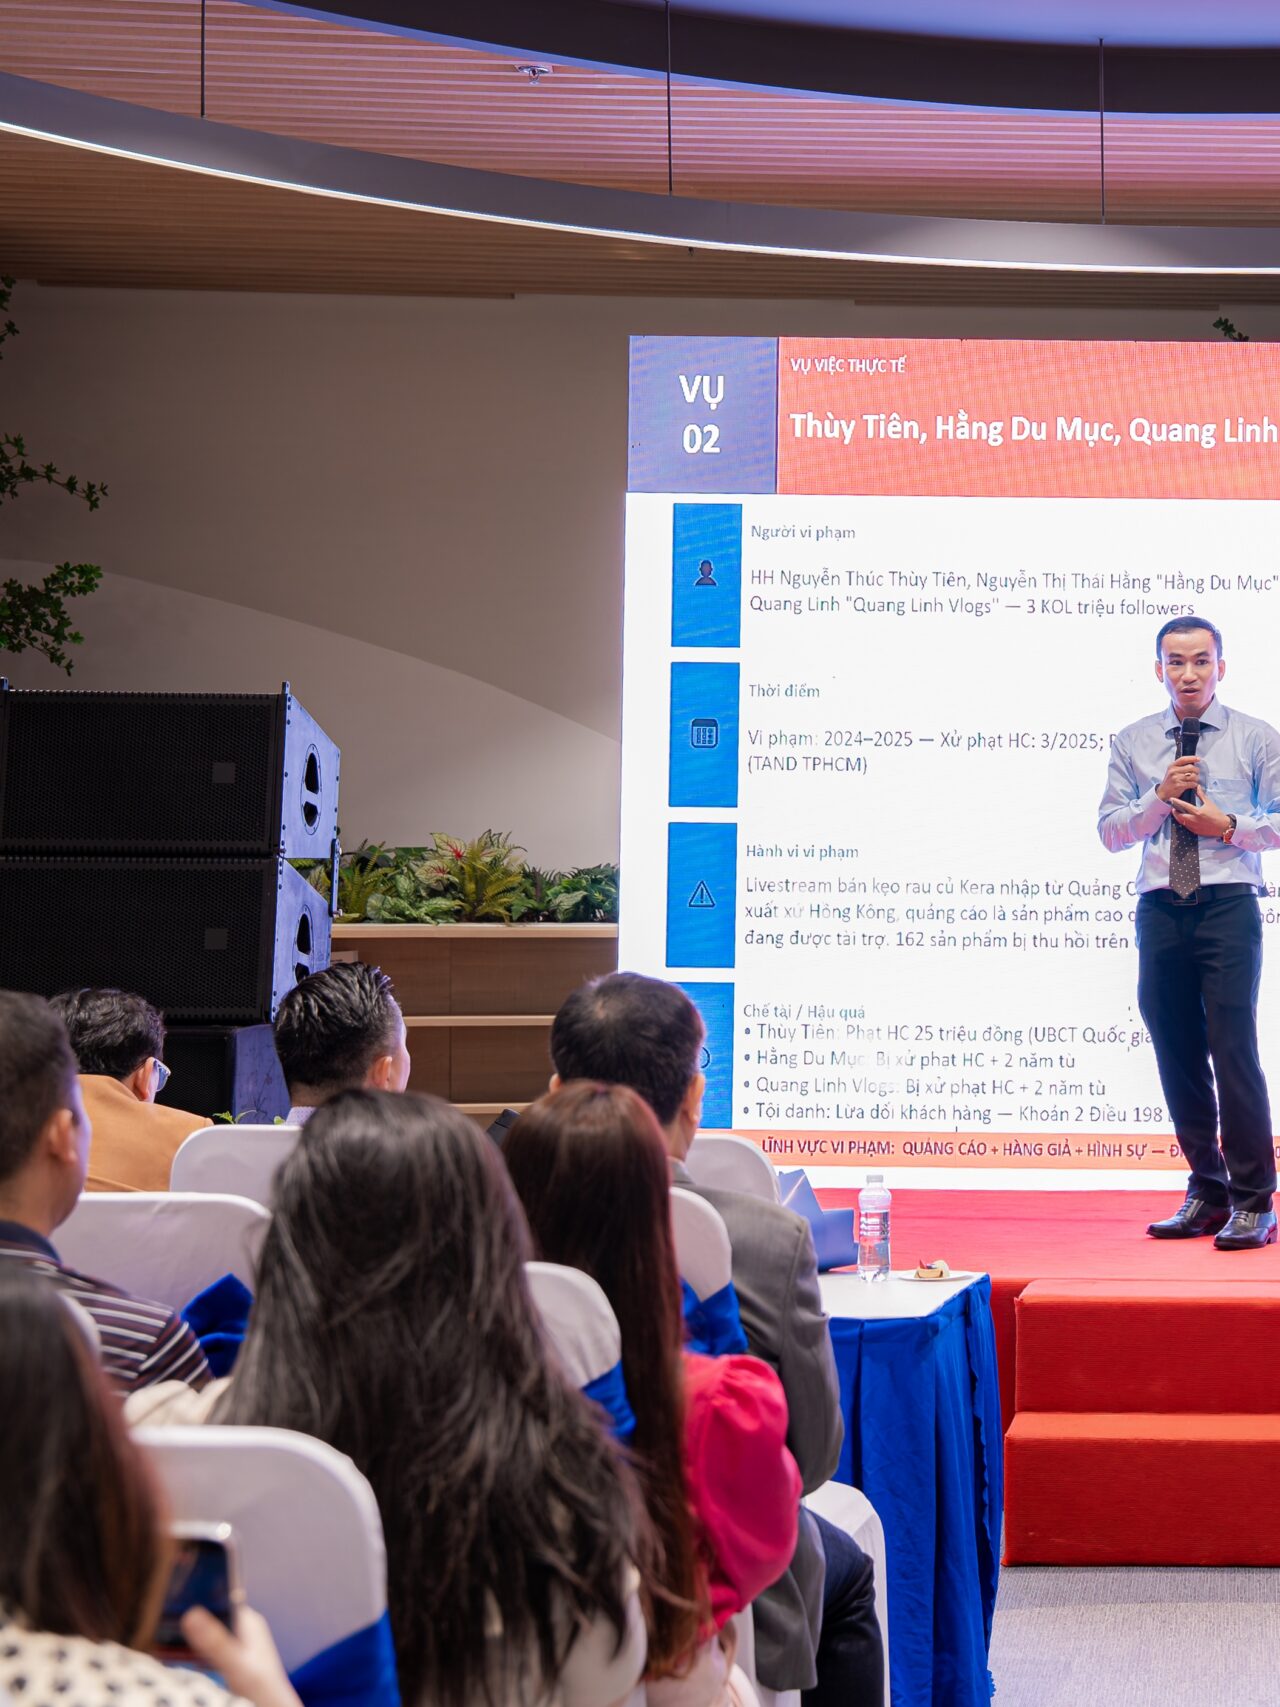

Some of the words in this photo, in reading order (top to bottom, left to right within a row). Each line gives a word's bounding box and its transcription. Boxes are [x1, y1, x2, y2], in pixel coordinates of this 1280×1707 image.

[790, 358, 811, 376] VỤ
[815, 355, 844, 376] VIỆC
[848, 357, 886, 376] THỰC
[888, 354, 907, 373] TẾ
[679, 374, 724, 410] VỤ
[790, 411, 855, 446] Thùy
[863, 412, 927, 445] Tiên,
[937, 406, 1003, 447] Hằng
[1012, 415, 1046, 441] Du
[1057, 415, 1121, 447] Mục,
[1130, 416, 1216, 448] Quang
[1225, 414, 1277, 442] Linh
[683, 425, 720, 456] 02
[751, 525, 795, 543] Người
[800, 526, 811, 540] vi
[816, 526, 855, 543] phạm
[752, 571, 774, 586] HH
[781, 566, 840, 590] Nguyễn
[847, 570, 883, 587] Thúc
[889, 571, 927, 591] Thùy
[933, 571, 971, 590] Tiên,
[977, 568, 1036, 592] Nguyễn
[1042, 573, 1065, 592] Thị
[1071, 573, 1104, 589] Thái
[1111, 569, 1151, 593] Hằng
[1211, 575, 1230, 590] Du
[750, 597, 802, 615] Quang
[808, 596, 840, 612] Linh
[911, 597, 943, 613] Linh
[1027, 599, 1036, 614] 3
[1041, 599, 1072, 614] KOL
[1120, 599, 1194, 615] followers
[748, 684, 780, 697] Thời
[748, 731, 762, 746] Vi
[968, 733, 1003, 752] phạt
[1009, 734, 1035, 748] HC:
[747, 756, 800, 774] (TAND
[802, 757, 869, 775] TPHCM)
[747, 845, 783, 858] Hành
[787, 846, 800, 858] vi
[803, 846, 816, 858] vi
[819, 846, 858, 861] phạm
[747, 878, 831, 893] Livestream
[961, 880, 994, 895] Kera
[1068, 880, 1121, 900] Quảng
[745, 930, 784, 949] đang
[897, 932, 924, 947] 162
[1033, 932, 1058, 948] thu
[1095, 932, 1128, 948] trên
[756, 1023, 796, 1044] Thùy
[888, 1025, 909, 1041] HC
[915, 1026, 933, 1041] 25
[757, 1078, 809, 1096] Quang
[815, 1077, 846, 1093] Linh
[785, 1102, 830, 1119] danh:
[901, 1103, 946, 1120] khách
[953, 1103, 991, 1125] hàng
[1133, 1107, 1162, 1123] 198
[797, 1140, 827, 1158] VỰC
[831, 1140, 844, 1155] VI
[849, 1141, 894, 1158] PHẠM:
[1004, 1137, 1042, 1156] HÀNG
[1048, 1138, 1071, 1156] GIẢ
[1127, 1143, 1147, 1160] SỰ
